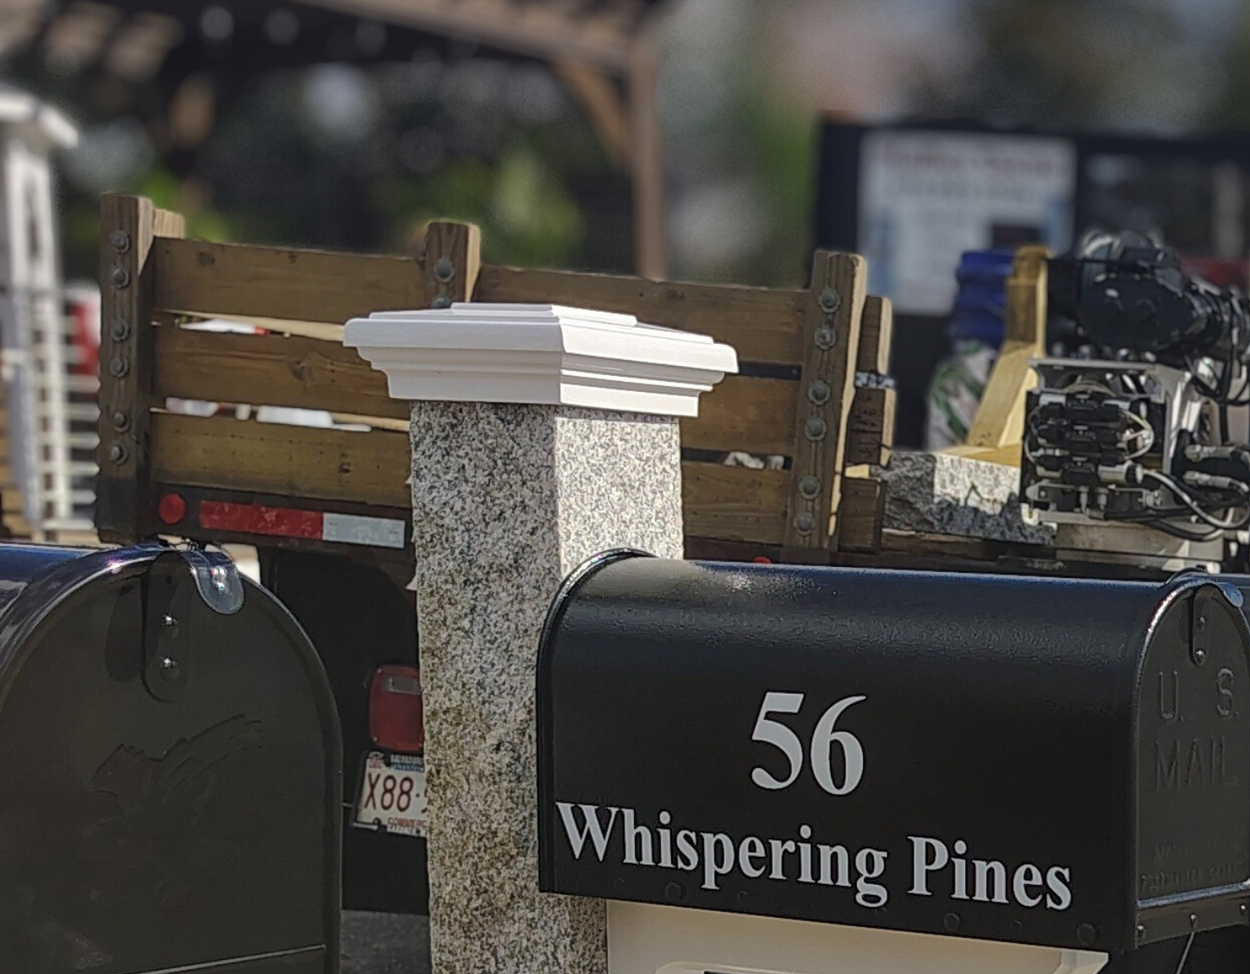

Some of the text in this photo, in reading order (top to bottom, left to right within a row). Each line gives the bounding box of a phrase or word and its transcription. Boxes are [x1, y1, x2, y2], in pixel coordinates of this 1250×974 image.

[364, 771, 427, 812] X88
[751, 691, 867, 796] 56
[554, 802, 1073, 911] Whispering Pines
